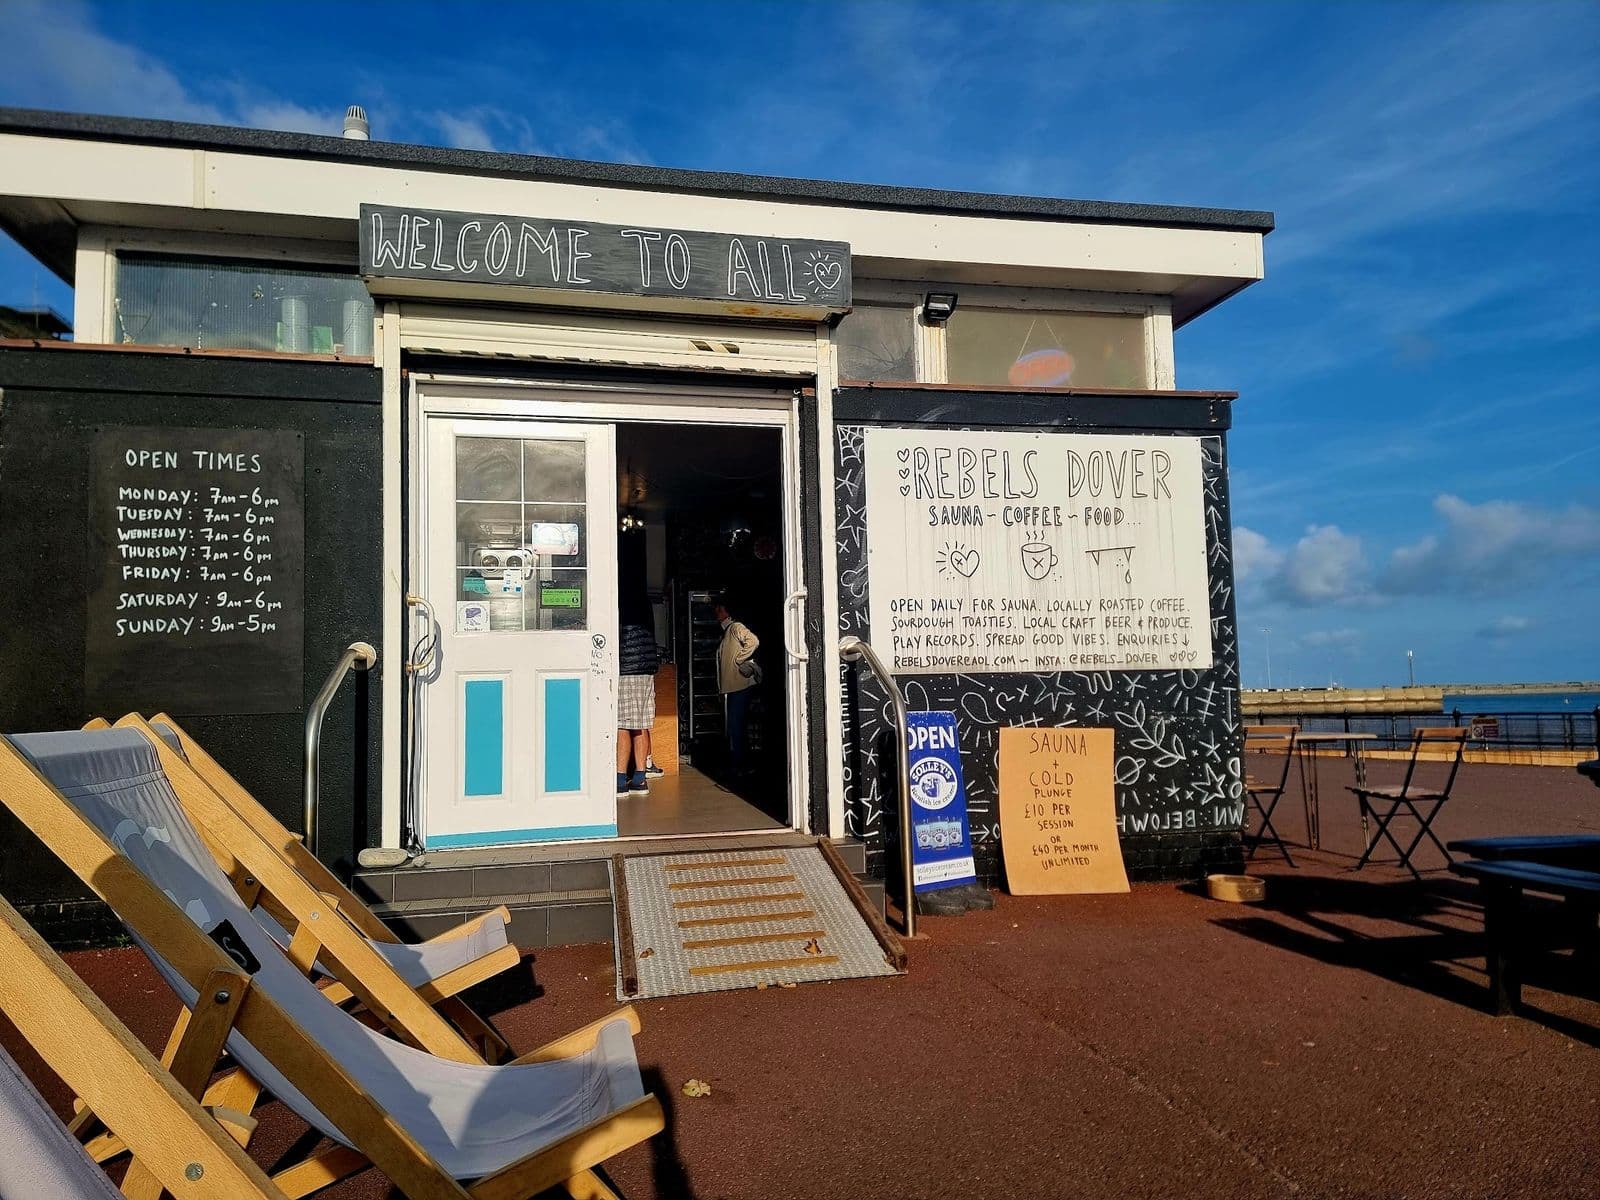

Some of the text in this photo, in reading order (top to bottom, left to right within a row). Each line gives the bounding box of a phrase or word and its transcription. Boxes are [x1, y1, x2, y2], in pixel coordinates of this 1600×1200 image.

[371, 212, 807, 301] WELCOME TO ALL
[125, 448, 261, 473] OPEN TIMES
[913, 446, 1173, 500] REBELS DOVER
[118, 486, 199, 507] MONDAY:
[928, 505, 984, 527] SAUNA
[1002, 505, 1063, 527] COFFEE
[890, 598, 923, 613] OPEN
[931, 598, 964, 613] DAILY
[972, 598, 997, 613] FOR
[1000, 598, 1041, 613] SAUNA.
[1046, 599, 1092, 613] LOCALLY
[1099, 598, 1145, 612] ROASTED
[890, 615, 954, 632] SOURDOUGH
[961, 615, 1017, 630] TOASTIES.
[1023, 615, 1057, 630] LOCAL
[1061, 615, 1097, 630] CRAFT
[1104, 615, 1133, 629] BEER
[893, 632, 1178, 651] PLAY RECORDS. SPREAD GOOD VIBES. ENQUIRIES
[1029, 732, 1088, 756] SAUNA
[911, 761, 953, 782] SOLLEY'S
[1052, 759, 1060, 769] +
[1029, 770, 1075, 788] COLD
[1034, 788, 1073, 799] PLUNGE
[1024, 803, 1071, 819] £10 PER
[1037, 820, 1075, 832] SESSION
[1050, 835, 1062, 844] OR
[1032, 843, 1100, 856] £40 PER MONTH
[1041, 857, 1091, 871] UNLIMITED
